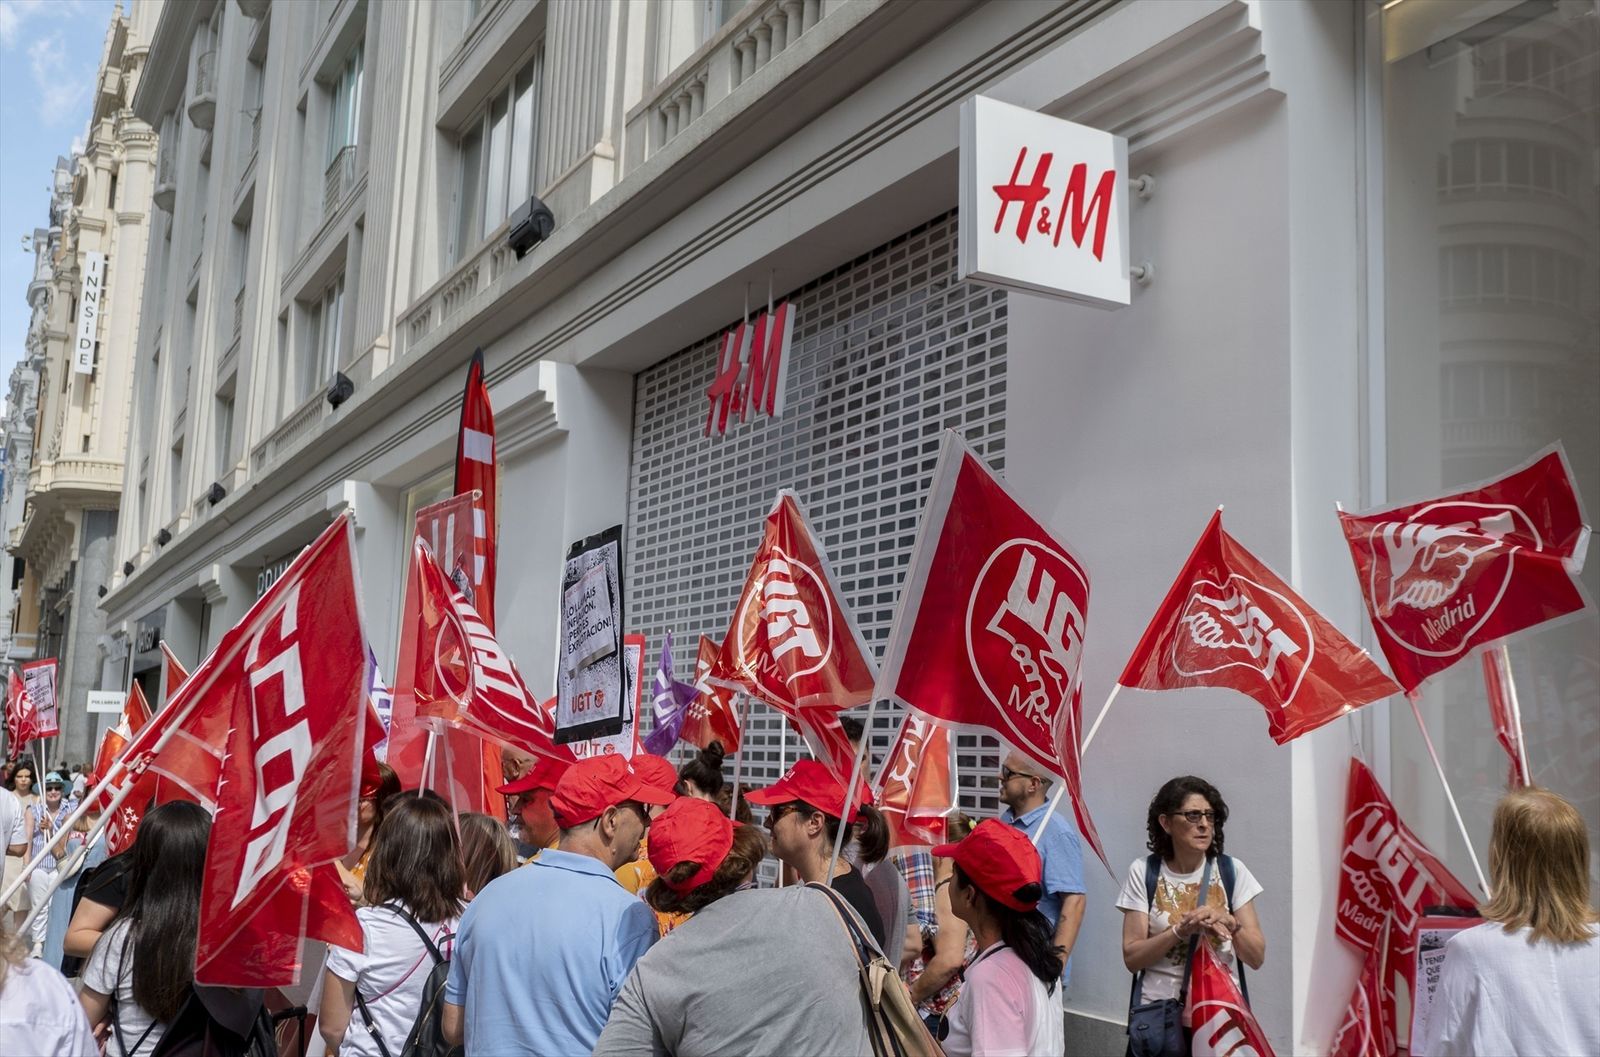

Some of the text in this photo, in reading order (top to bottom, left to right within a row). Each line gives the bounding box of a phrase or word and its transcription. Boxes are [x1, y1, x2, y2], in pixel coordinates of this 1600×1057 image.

[992, 146, 1117, 263] H&M
[705, 301, 796, 438] H&M
[1420, 592, 1477, 645] Madrid
[571, 691, 593, 714] UGT
[1339, 898, 1382, 934] Madr
